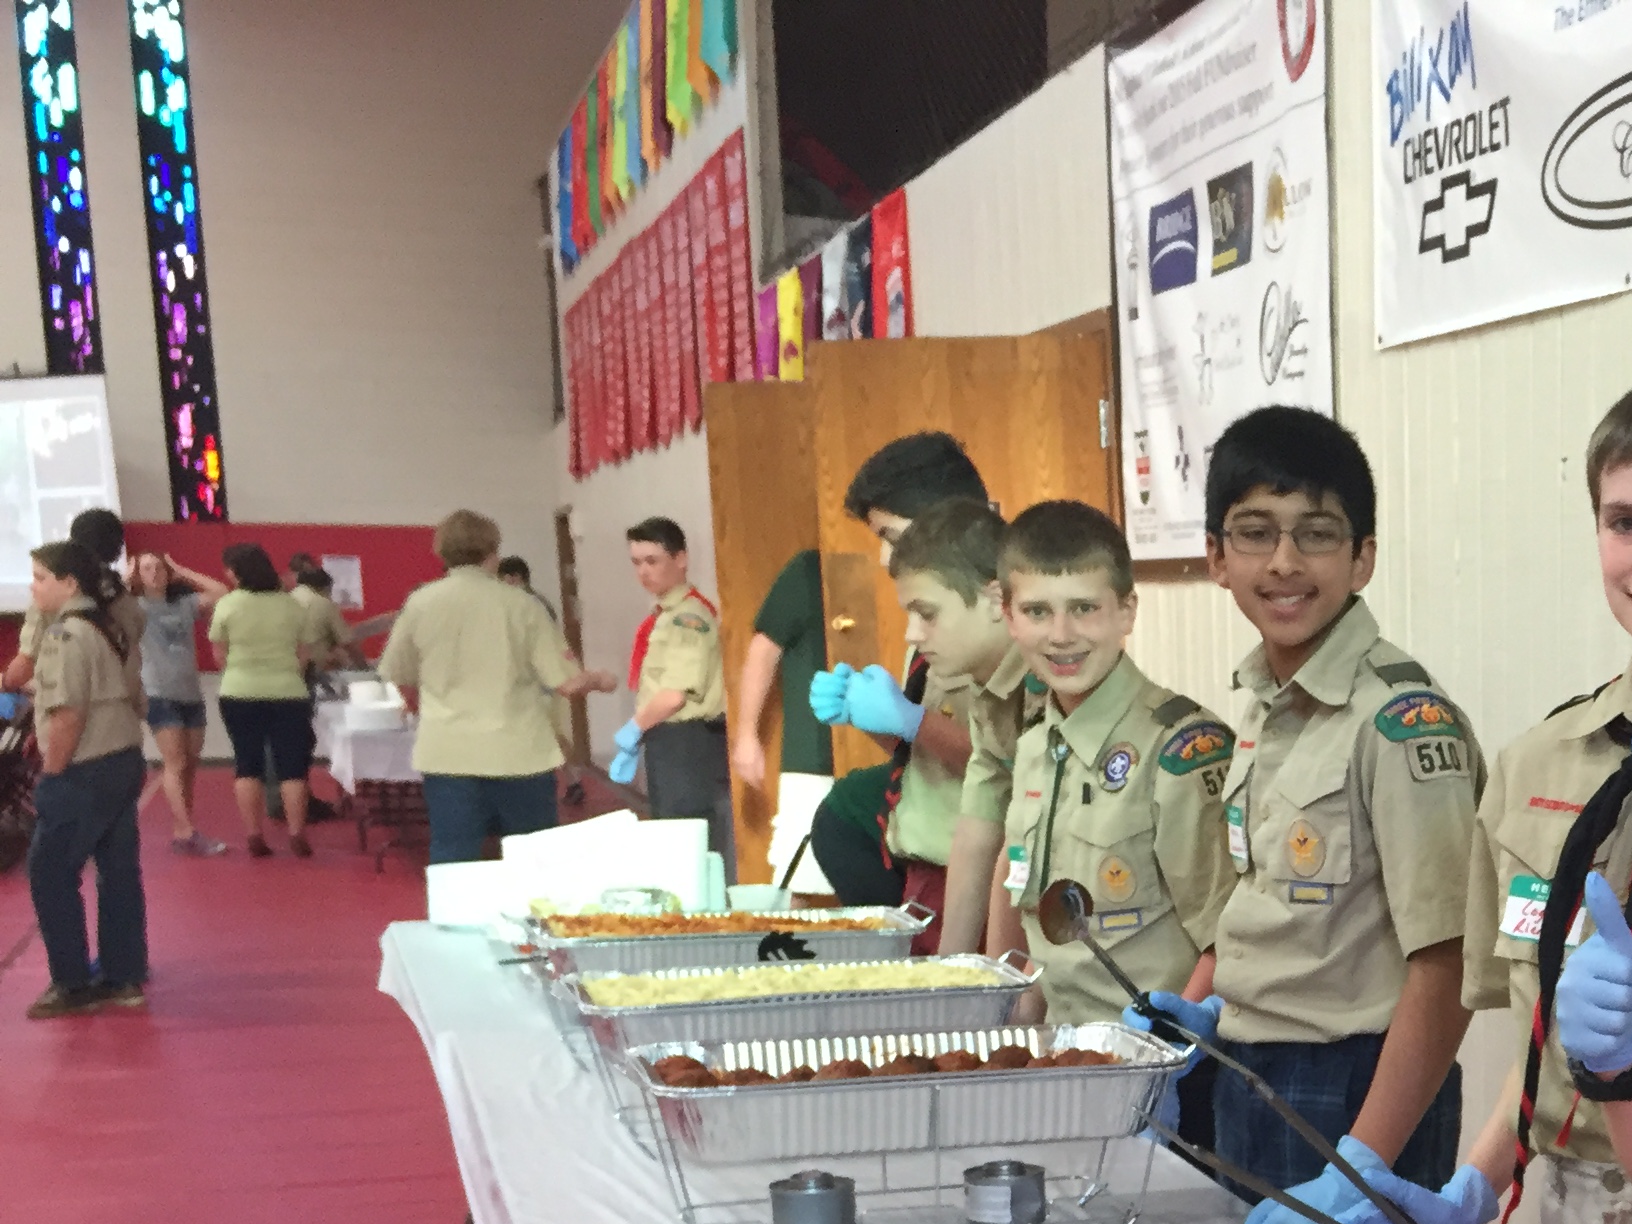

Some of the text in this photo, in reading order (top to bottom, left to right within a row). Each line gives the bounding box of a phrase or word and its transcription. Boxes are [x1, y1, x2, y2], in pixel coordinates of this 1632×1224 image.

[1403, 95, 1510, 184] CHEVROLET
[1416, 741, 1462, 774] 510
[1202, 765, 1230, 796] 51
